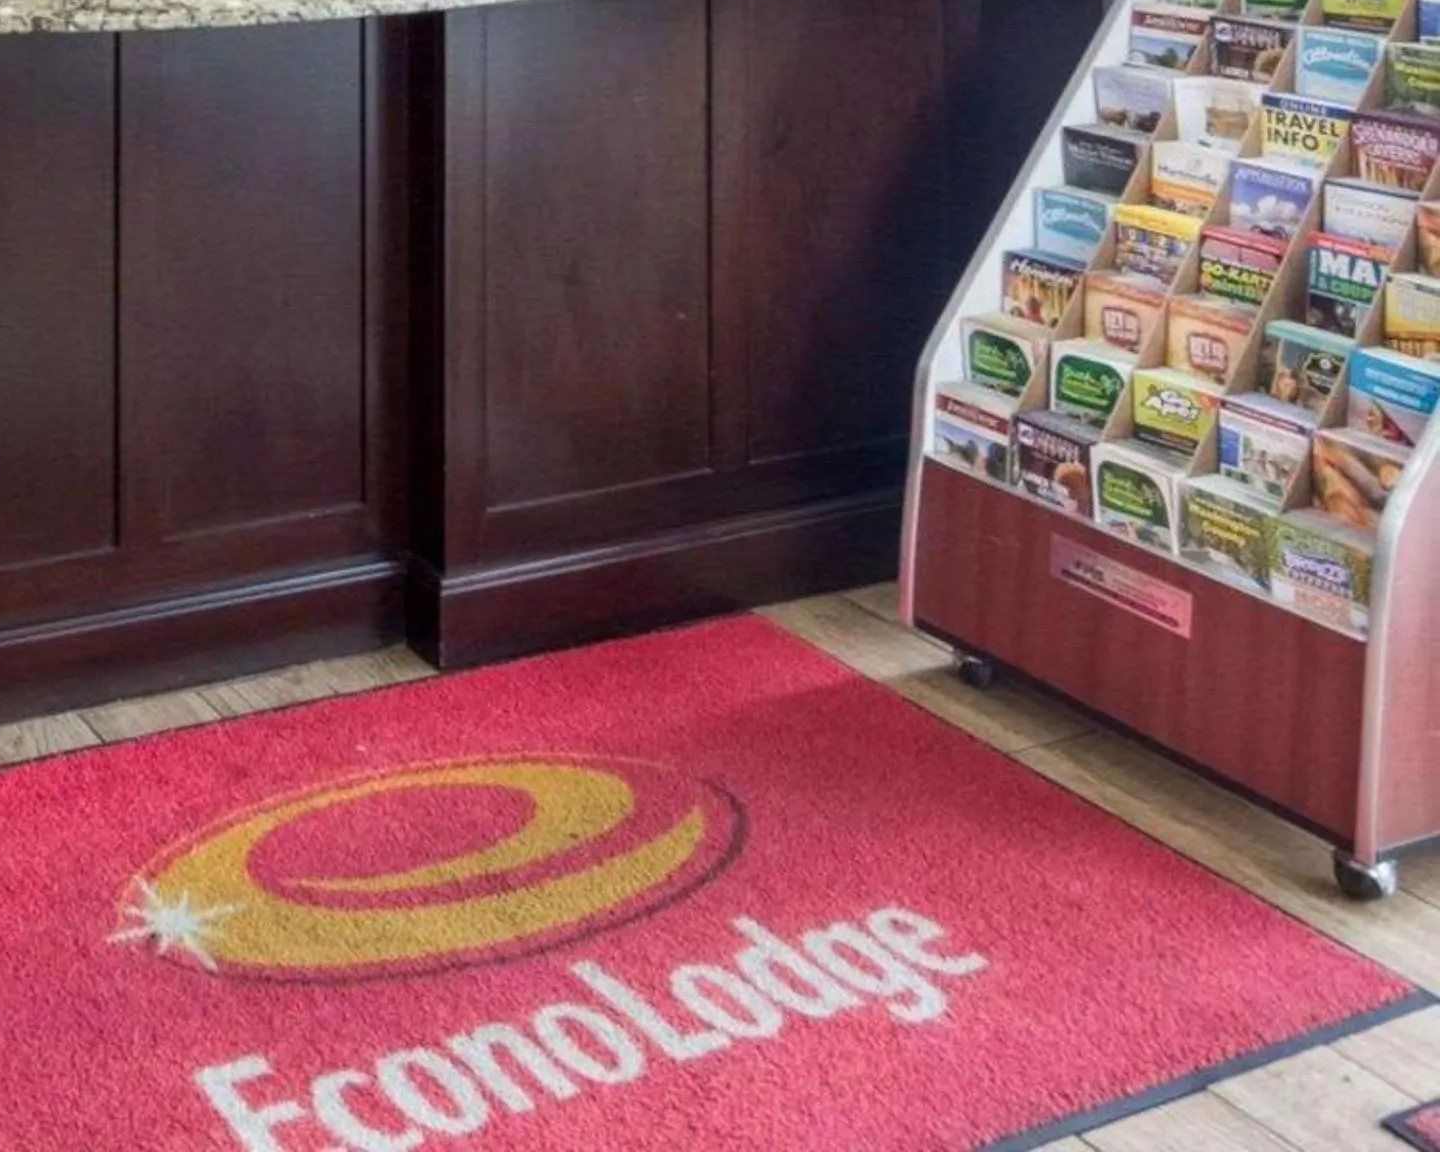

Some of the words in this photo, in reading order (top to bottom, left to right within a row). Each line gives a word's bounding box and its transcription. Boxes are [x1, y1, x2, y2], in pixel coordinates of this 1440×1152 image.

[1265, 108, 1340, 137] TRAVEL
[1266, 127, 1320, 151] INFO
[194, 903, 988, 1152] EconoLodge
